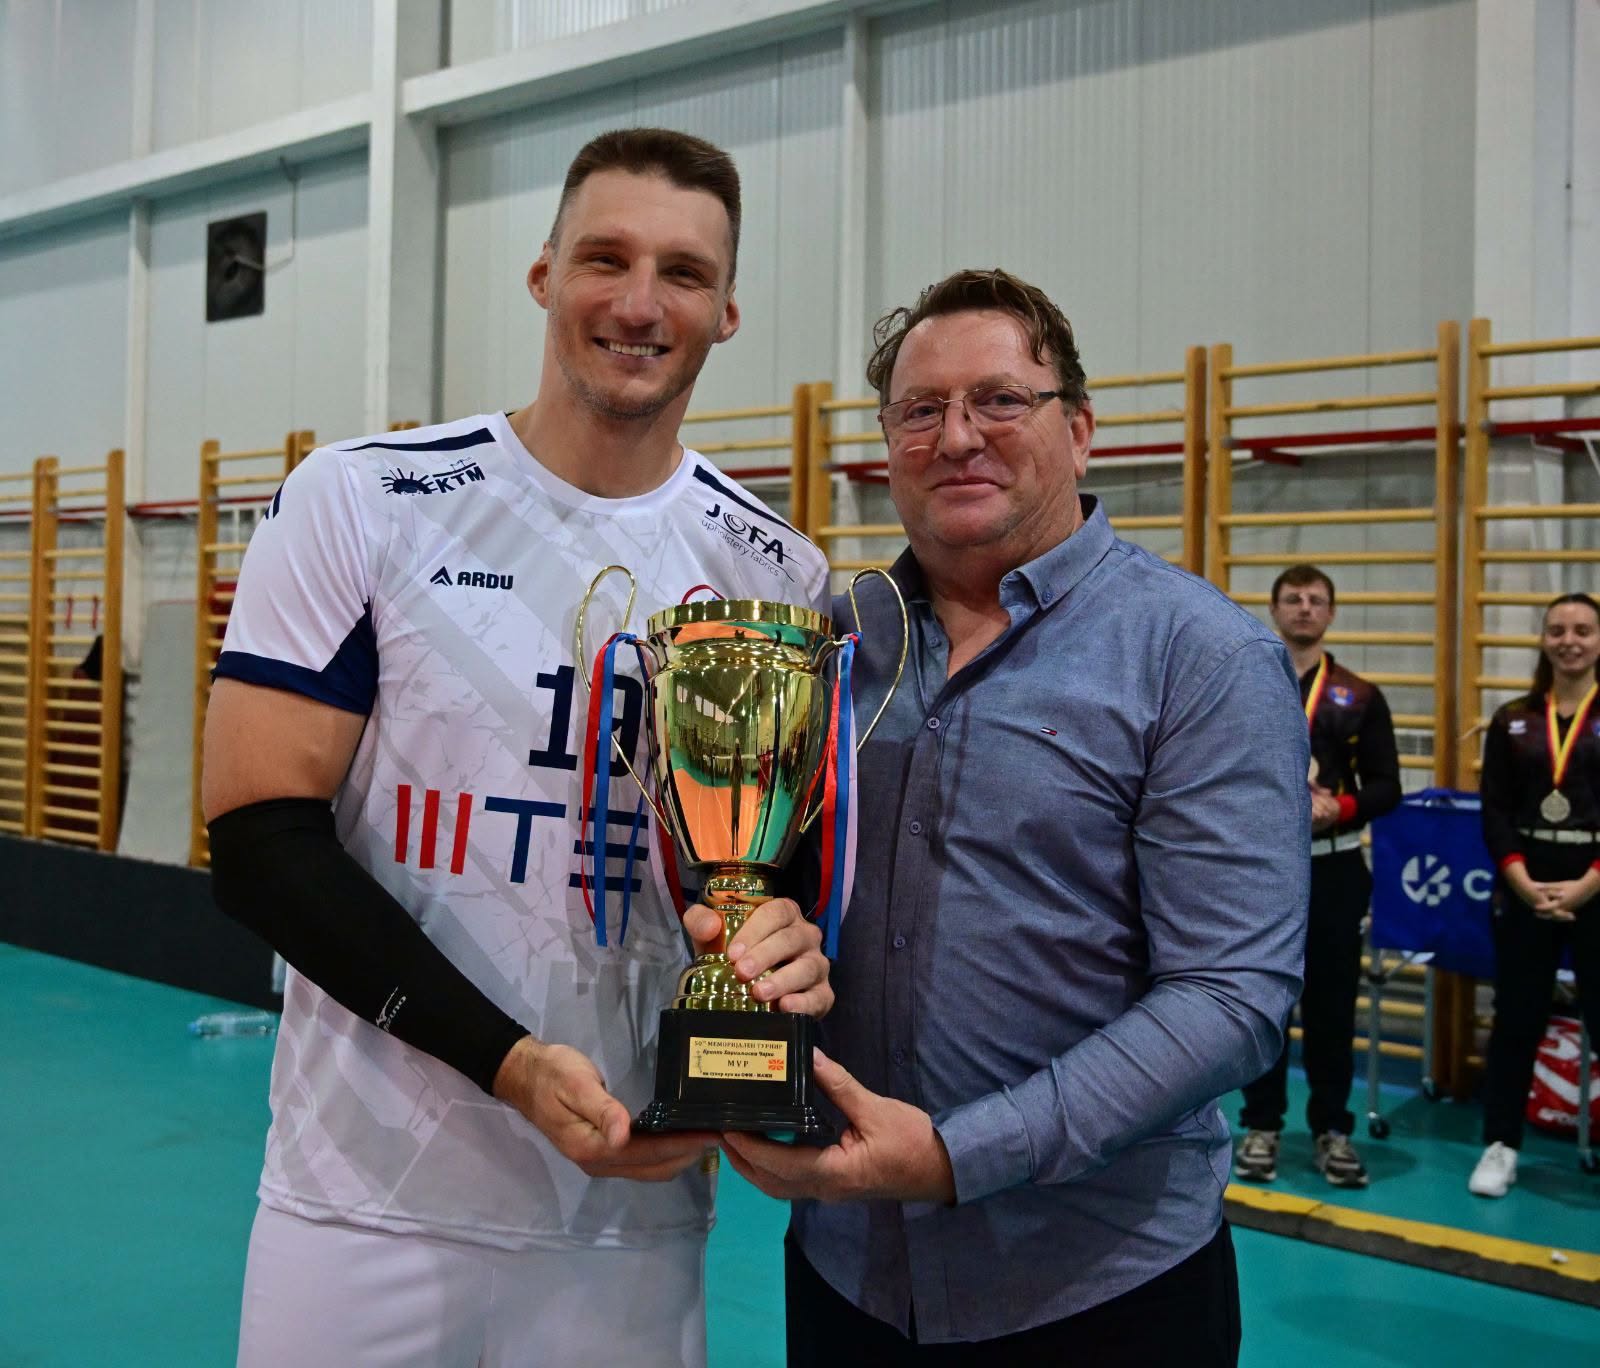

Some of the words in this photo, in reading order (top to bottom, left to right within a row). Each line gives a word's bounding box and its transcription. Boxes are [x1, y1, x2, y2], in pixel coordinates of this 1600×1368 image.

[701, 519, 750, 556] upholstery
[750, 551, 780, 577] fabrics
[457, 571, 514, 590] ARDU
[528, 664, 643, 777] 19
[727, 1060, 749, 1068] MVP
